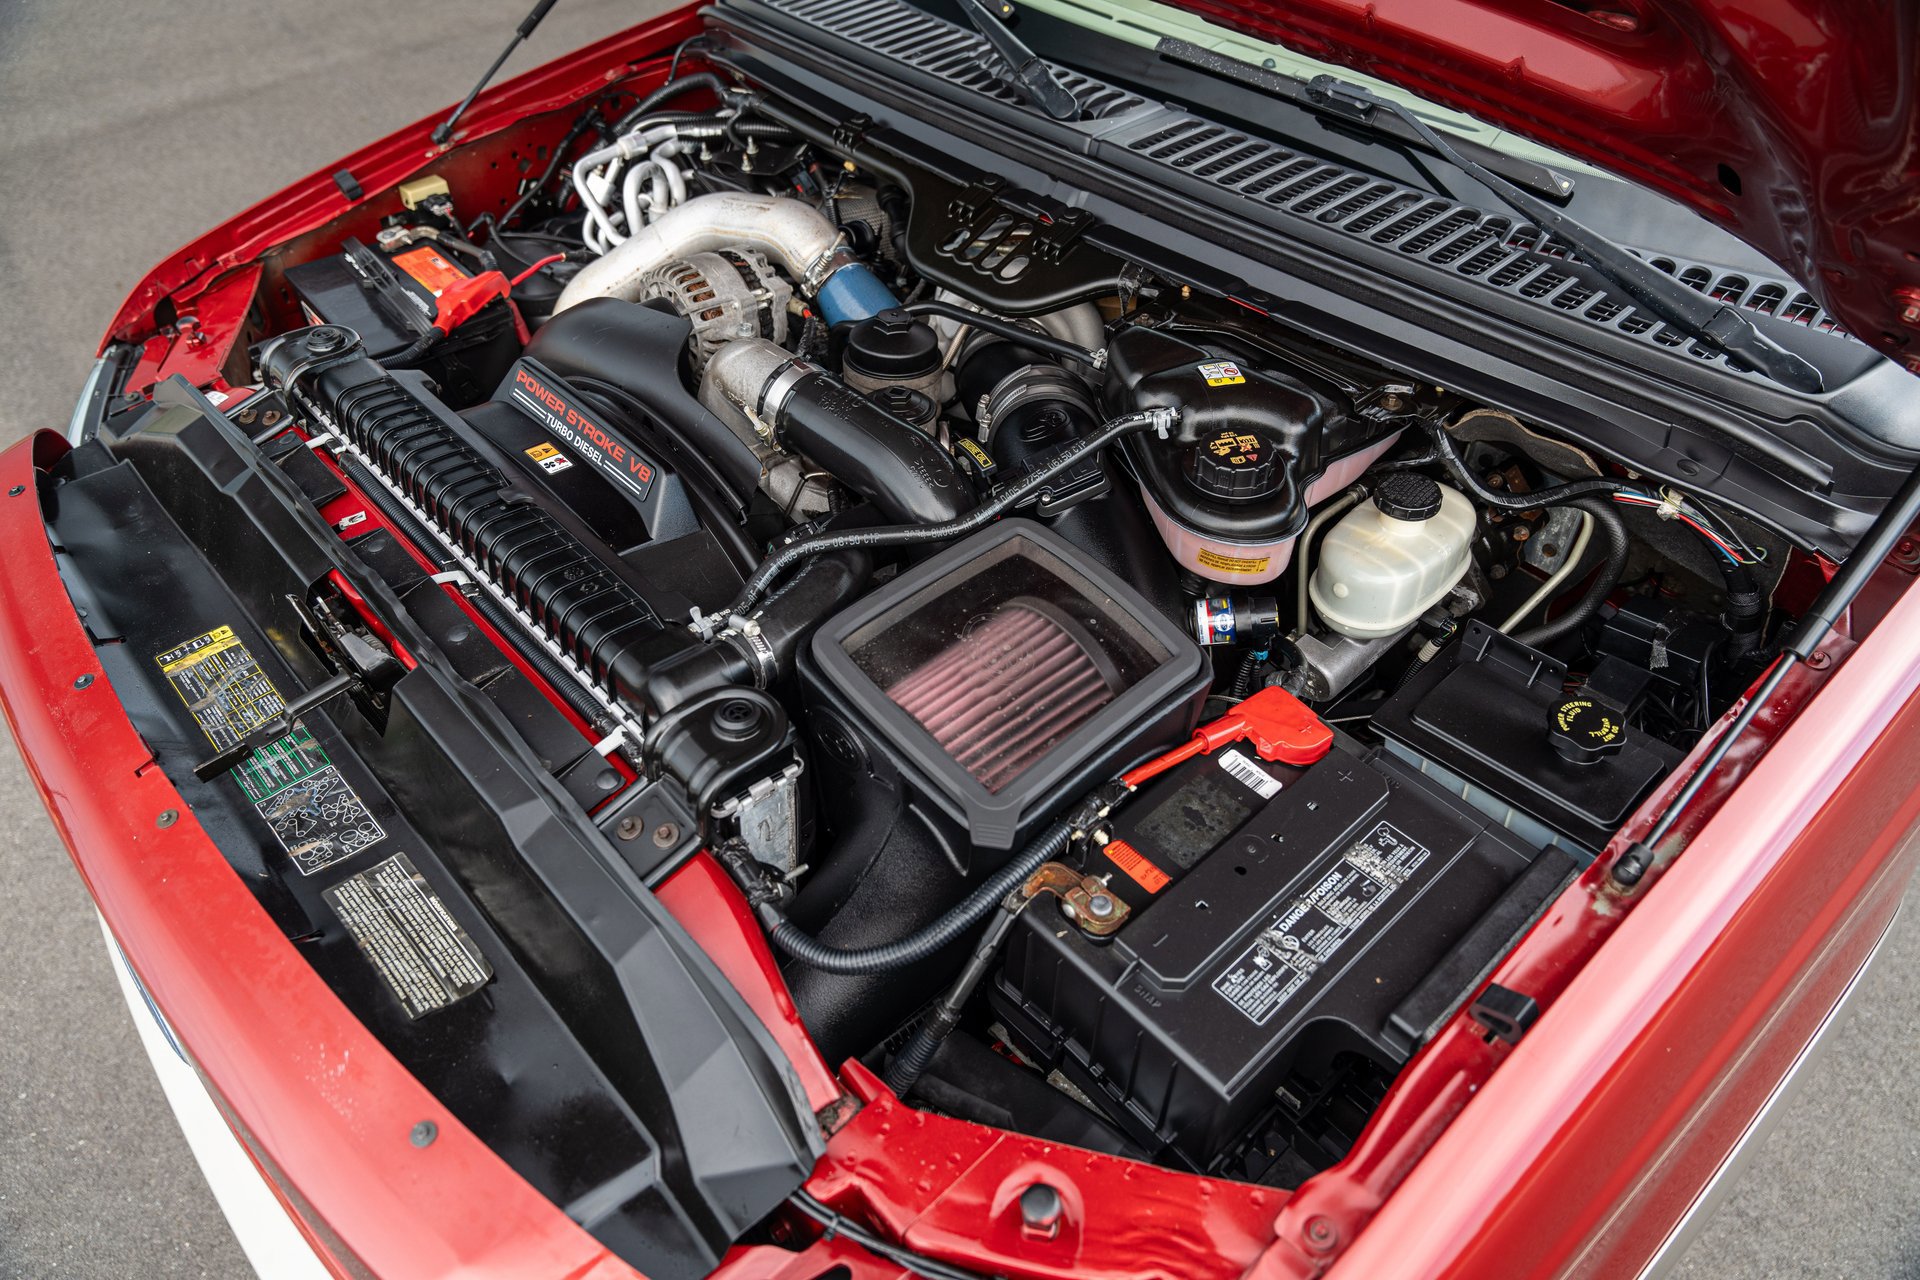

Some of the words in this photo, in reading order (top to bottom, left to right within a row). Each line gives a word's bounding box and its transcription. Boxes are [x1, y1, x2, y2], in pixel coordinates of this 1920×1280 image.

[516, 370, 566, 416] POWER
[566, 410, 626, 463] STROKE
[630, 456, 651, 483] V8
[545, 413, 573, 441] TURBO
[574, 436, 603, 466] DIESEL
[1561, 701, 1592, 712] STEERING
[1566, 708, 1582, 722] FLUID
[428, 895, 458, 931] MODIFICATIONS
